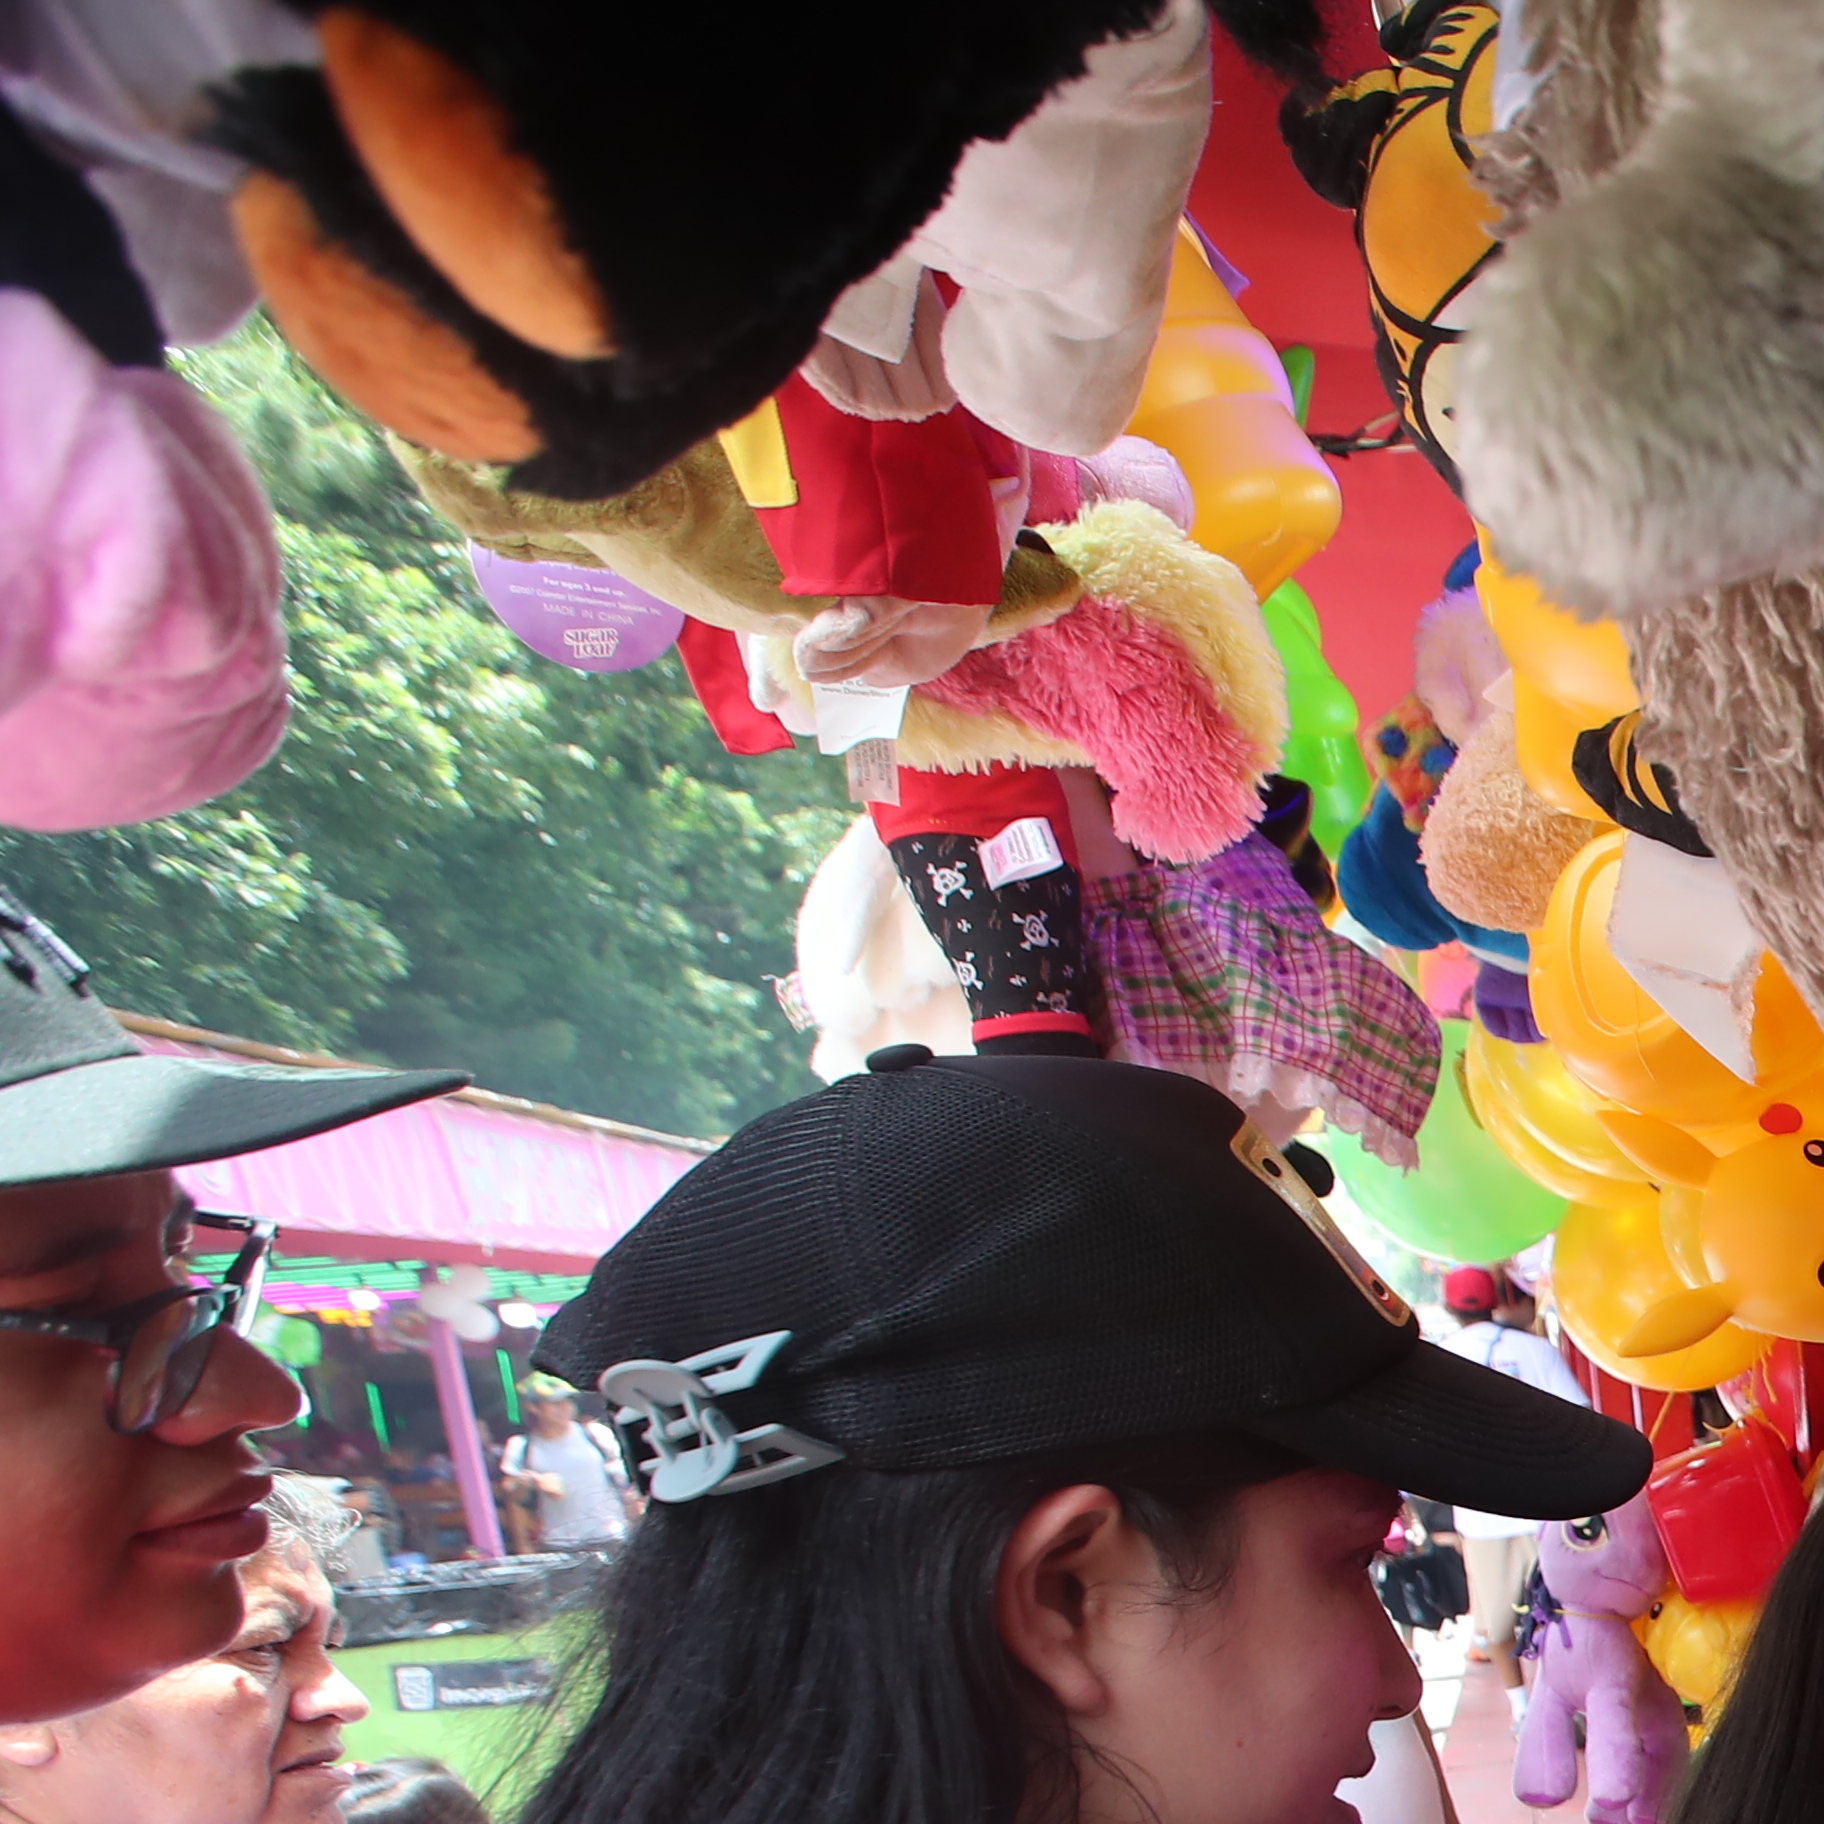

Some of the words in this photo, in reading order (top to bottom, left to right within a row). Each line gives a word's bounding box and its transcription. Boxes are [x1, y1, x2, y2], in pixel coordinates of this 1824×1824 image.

[543, 602, 576, 617] MADE
[582, 608, 594, 620] IN
[599, 611, 635, 626] CHINA
[563, 627, 619, 646] SUGAR
